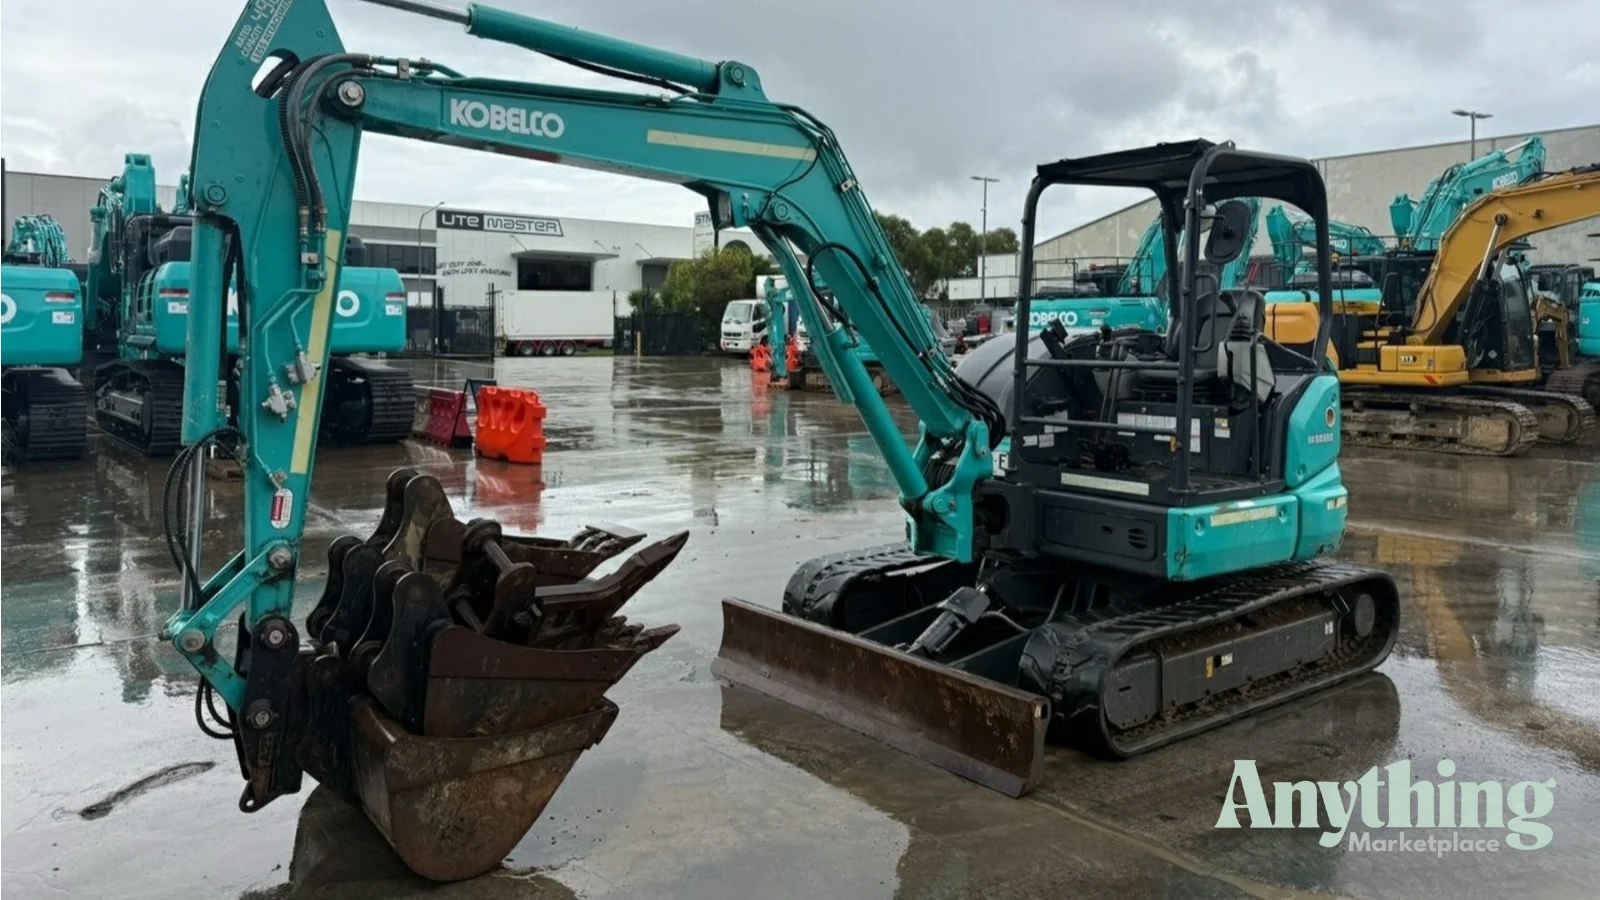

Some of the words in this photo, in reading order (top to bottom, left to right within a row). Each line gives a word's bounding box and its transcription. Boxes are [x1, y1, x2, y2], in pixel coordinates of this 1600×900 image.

[234, 24, 252, 49] RATED
[241, 23, 263, 58] CAPACITY
[252, 41, 268, 61] LESS
[450, 98, 565, 139] KOBELCO
[1029, 311, 1078, 326] OBELCO
